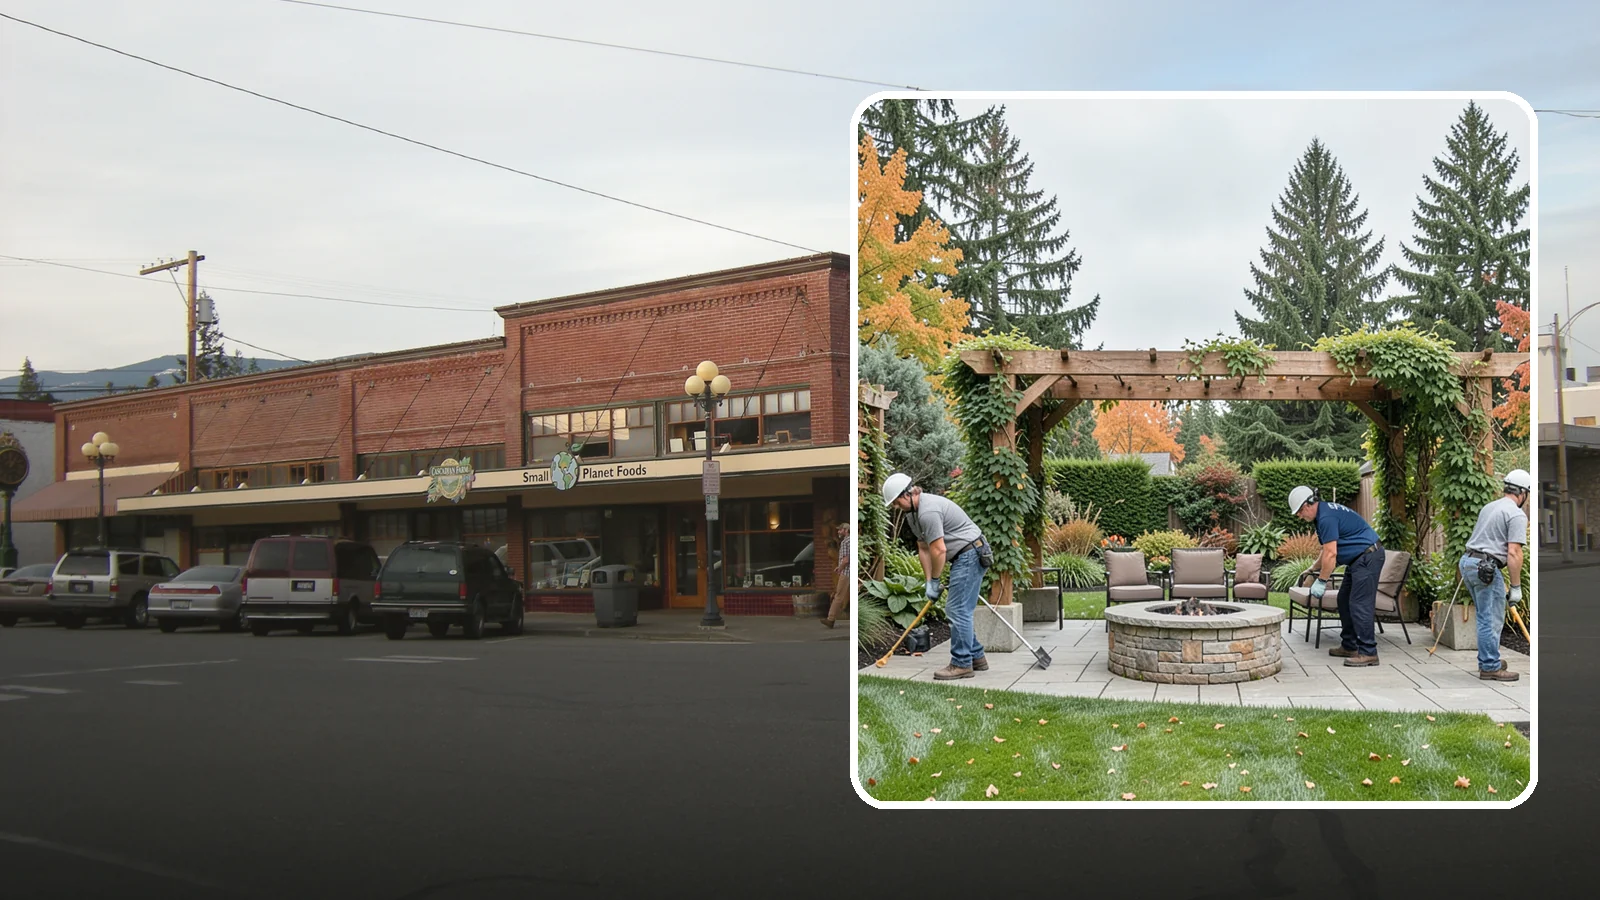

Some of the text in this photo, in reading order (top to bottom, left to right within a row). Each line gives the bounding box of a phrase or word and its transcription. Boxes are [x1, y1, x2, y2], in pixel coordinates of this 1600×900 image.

[523, 464, 647, 483] Small Planet Foods
